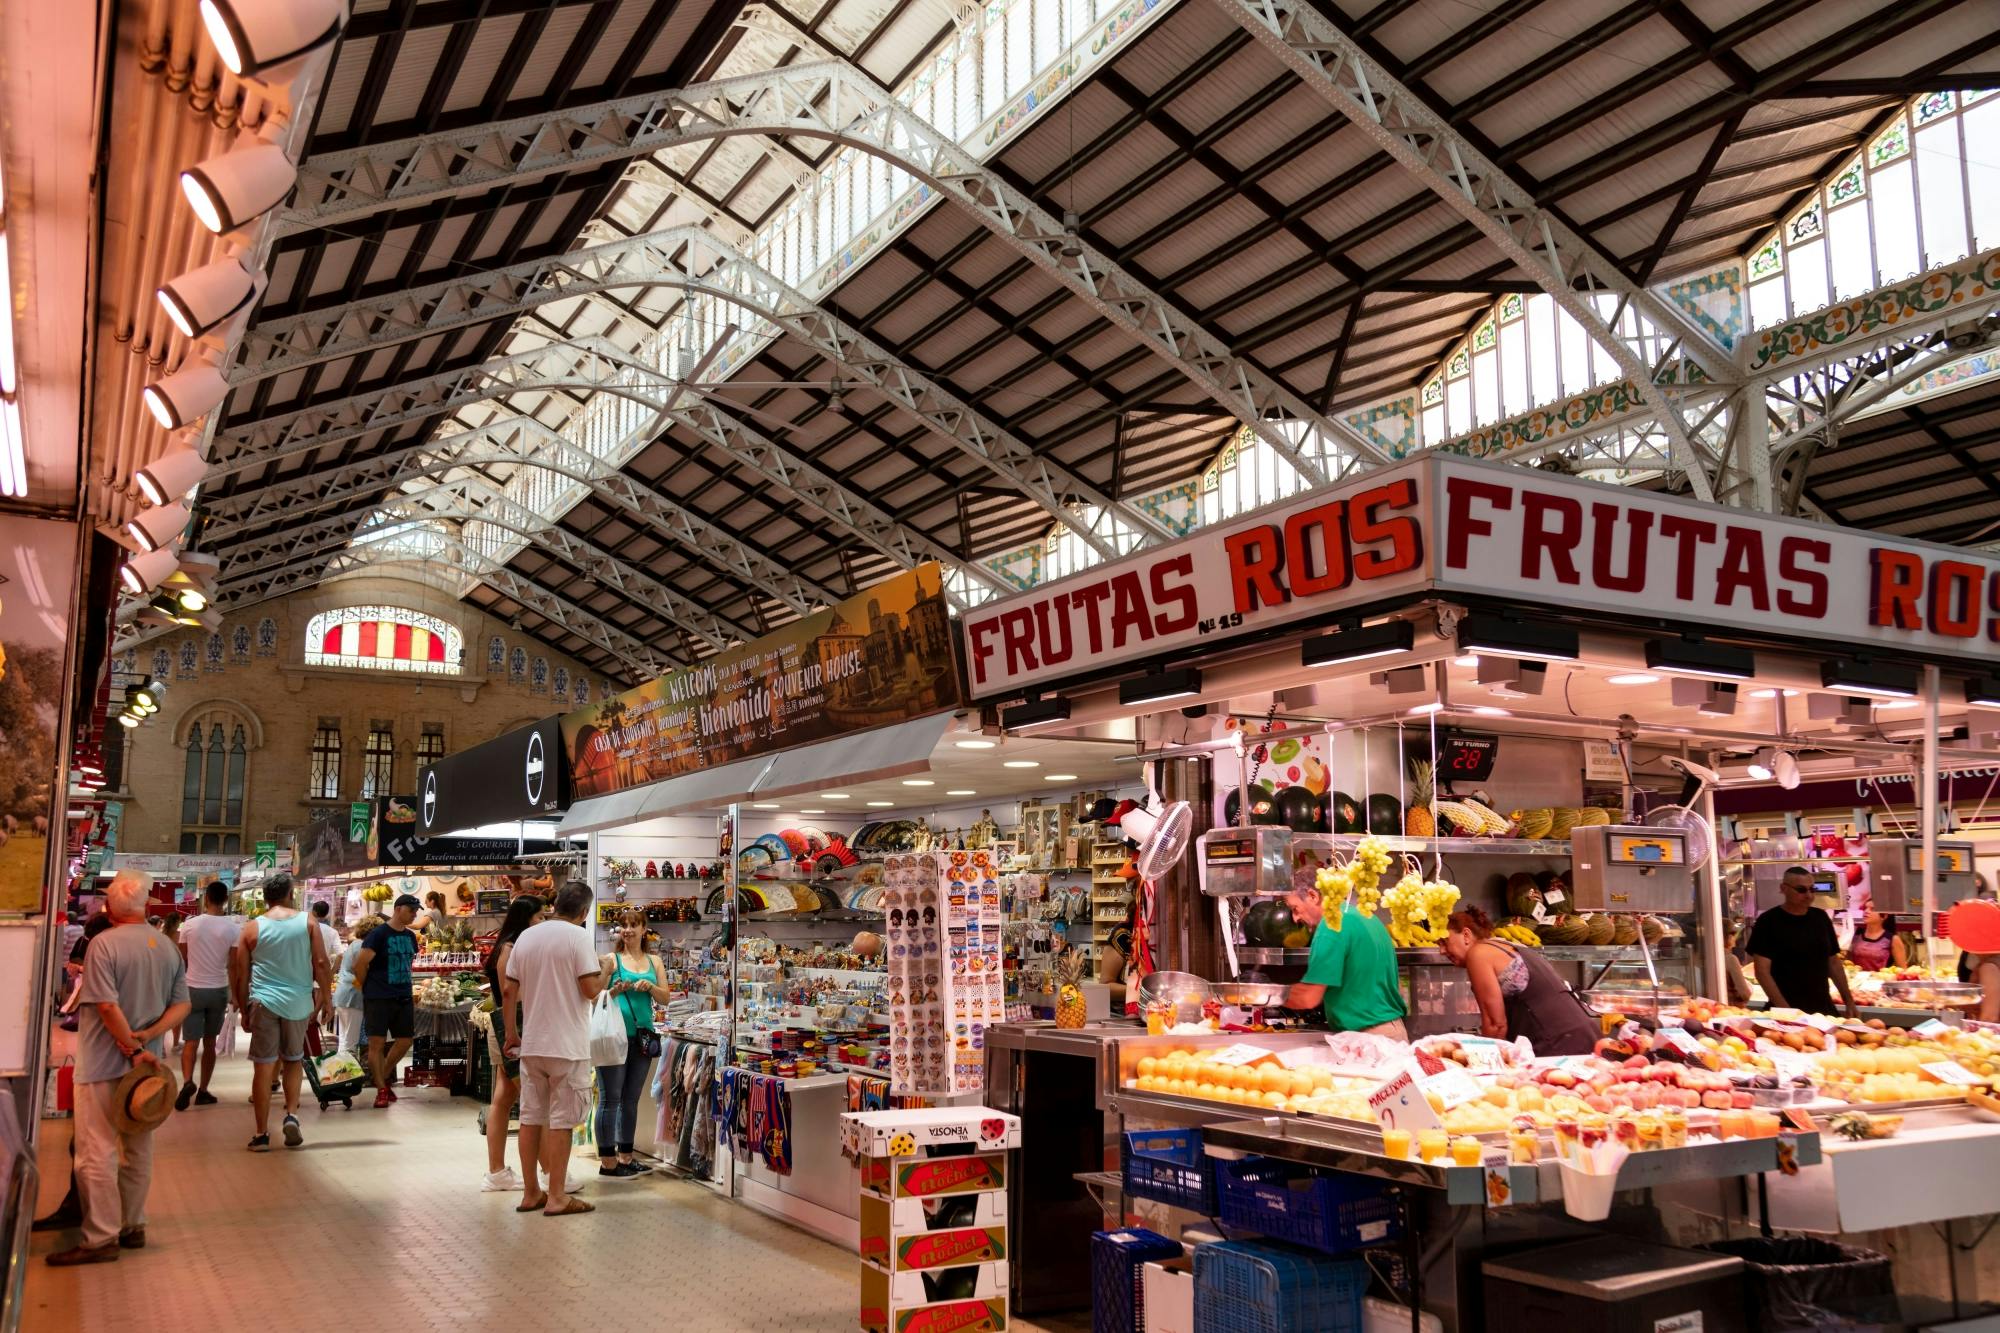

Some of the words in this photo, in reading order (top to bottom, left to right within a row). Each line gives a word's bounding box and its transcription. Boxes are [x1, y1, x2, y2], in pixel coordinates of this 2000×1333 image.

[1445, 477, 1831, 619] FRUTAS
[1870, 547, 2000, 643] RO
[969, 553, 1199, 685] FRUTAS
[1225, 478, 1424, 615] ROS
[1218, 612, 1243, 630] 49
[669, 663, 719, 705] WELCOME
[719, 666, 730, 680] CASA
[731, 663, 739, 674] DE
[772, 663, 823, 700] SOUVENIR
[825, 649, 863, 683] HOUSE
[699, 686, 771, 737] bienvenido
[594, 733, 612, 752] CASA
[612, 730, 621, 748] DE
[622, 719, 656, 745] SOUVENIRS
[1452, 749, 1481, 769] 28
[425, 853, 466, 861] Excelencia
[479, 852, 510, 861] calidad
[456, 839, 470, 849] SU
[471, 839, 519, 849] GOURMET
[928, 1126, 969, 1137] VENOSTA
